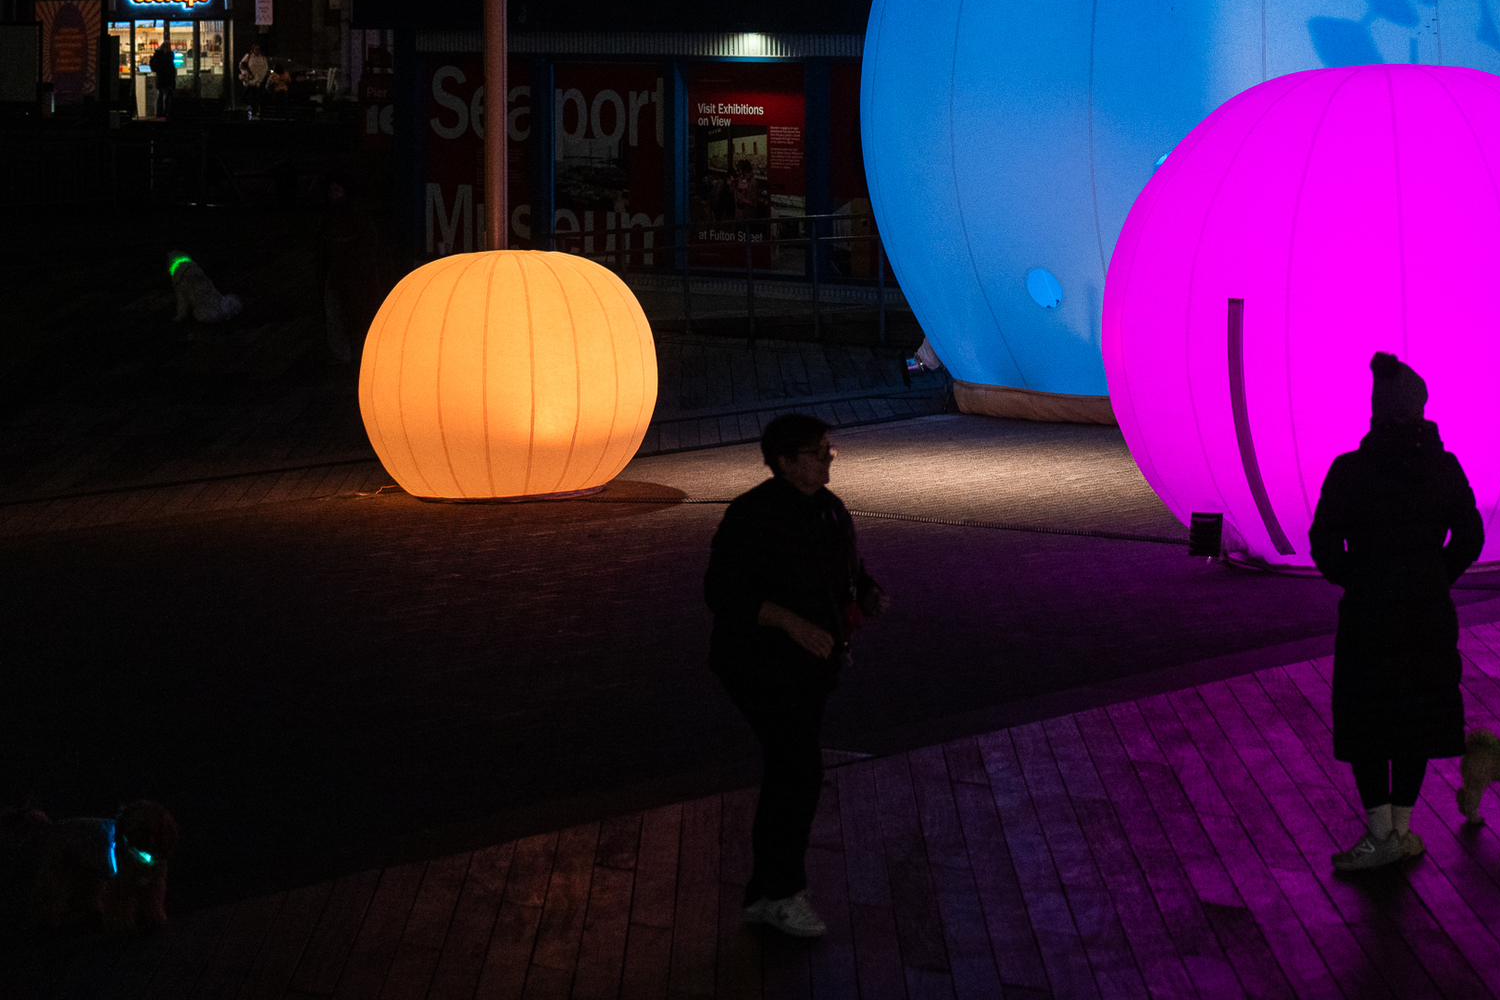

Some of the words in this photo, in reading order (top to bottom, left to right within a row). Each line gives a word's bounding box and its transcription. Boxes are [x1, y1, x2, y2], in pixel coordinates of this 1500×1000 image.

[366, 86, 388, 99] Pier
[698, 103, 716, 114] Visit
[718, 103, 765, 116] Exhibitions
[698, 117, 709, 127] on
[711, 115, 731, 127] View
[698, 230, 707, 240] at
[709, 229, 736, 241] Fulton
